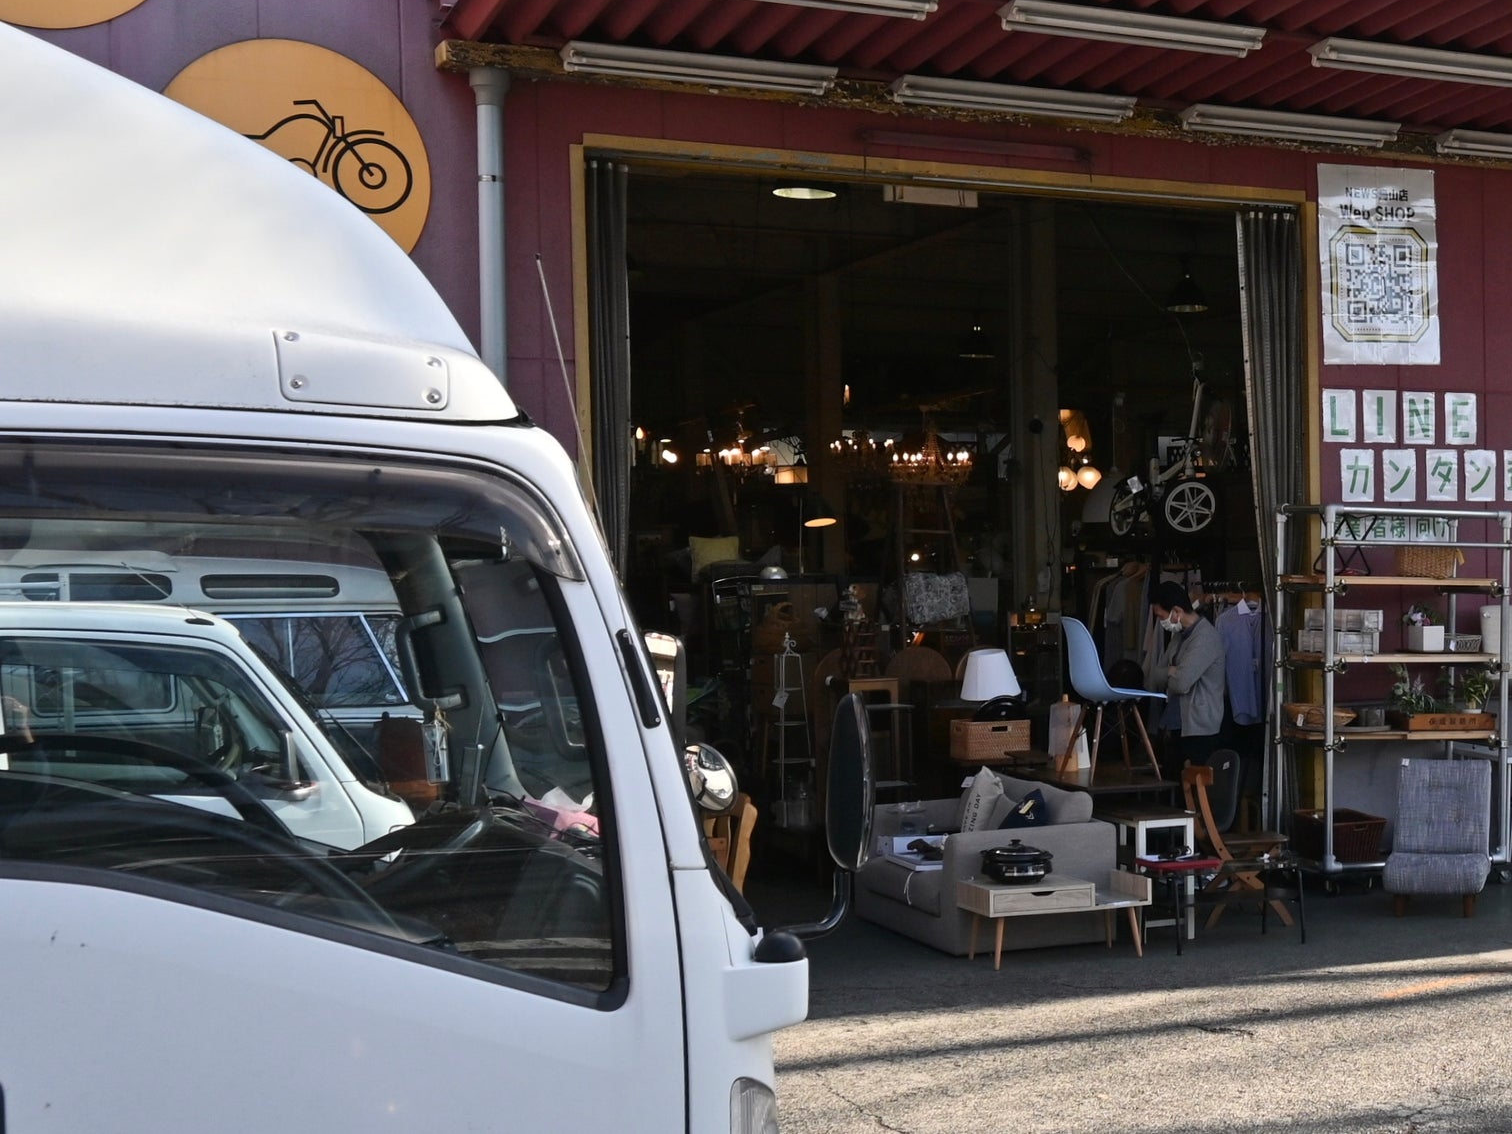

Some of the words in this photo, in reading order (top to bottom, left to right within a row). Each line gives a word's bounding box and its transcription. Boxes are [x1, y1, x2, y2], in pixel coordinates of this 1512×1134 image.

[1339, 204, 1370, 220] Web
[1375, 205, 1415, 222] SHOP
[1330, 395, 1470, 439] LINE
